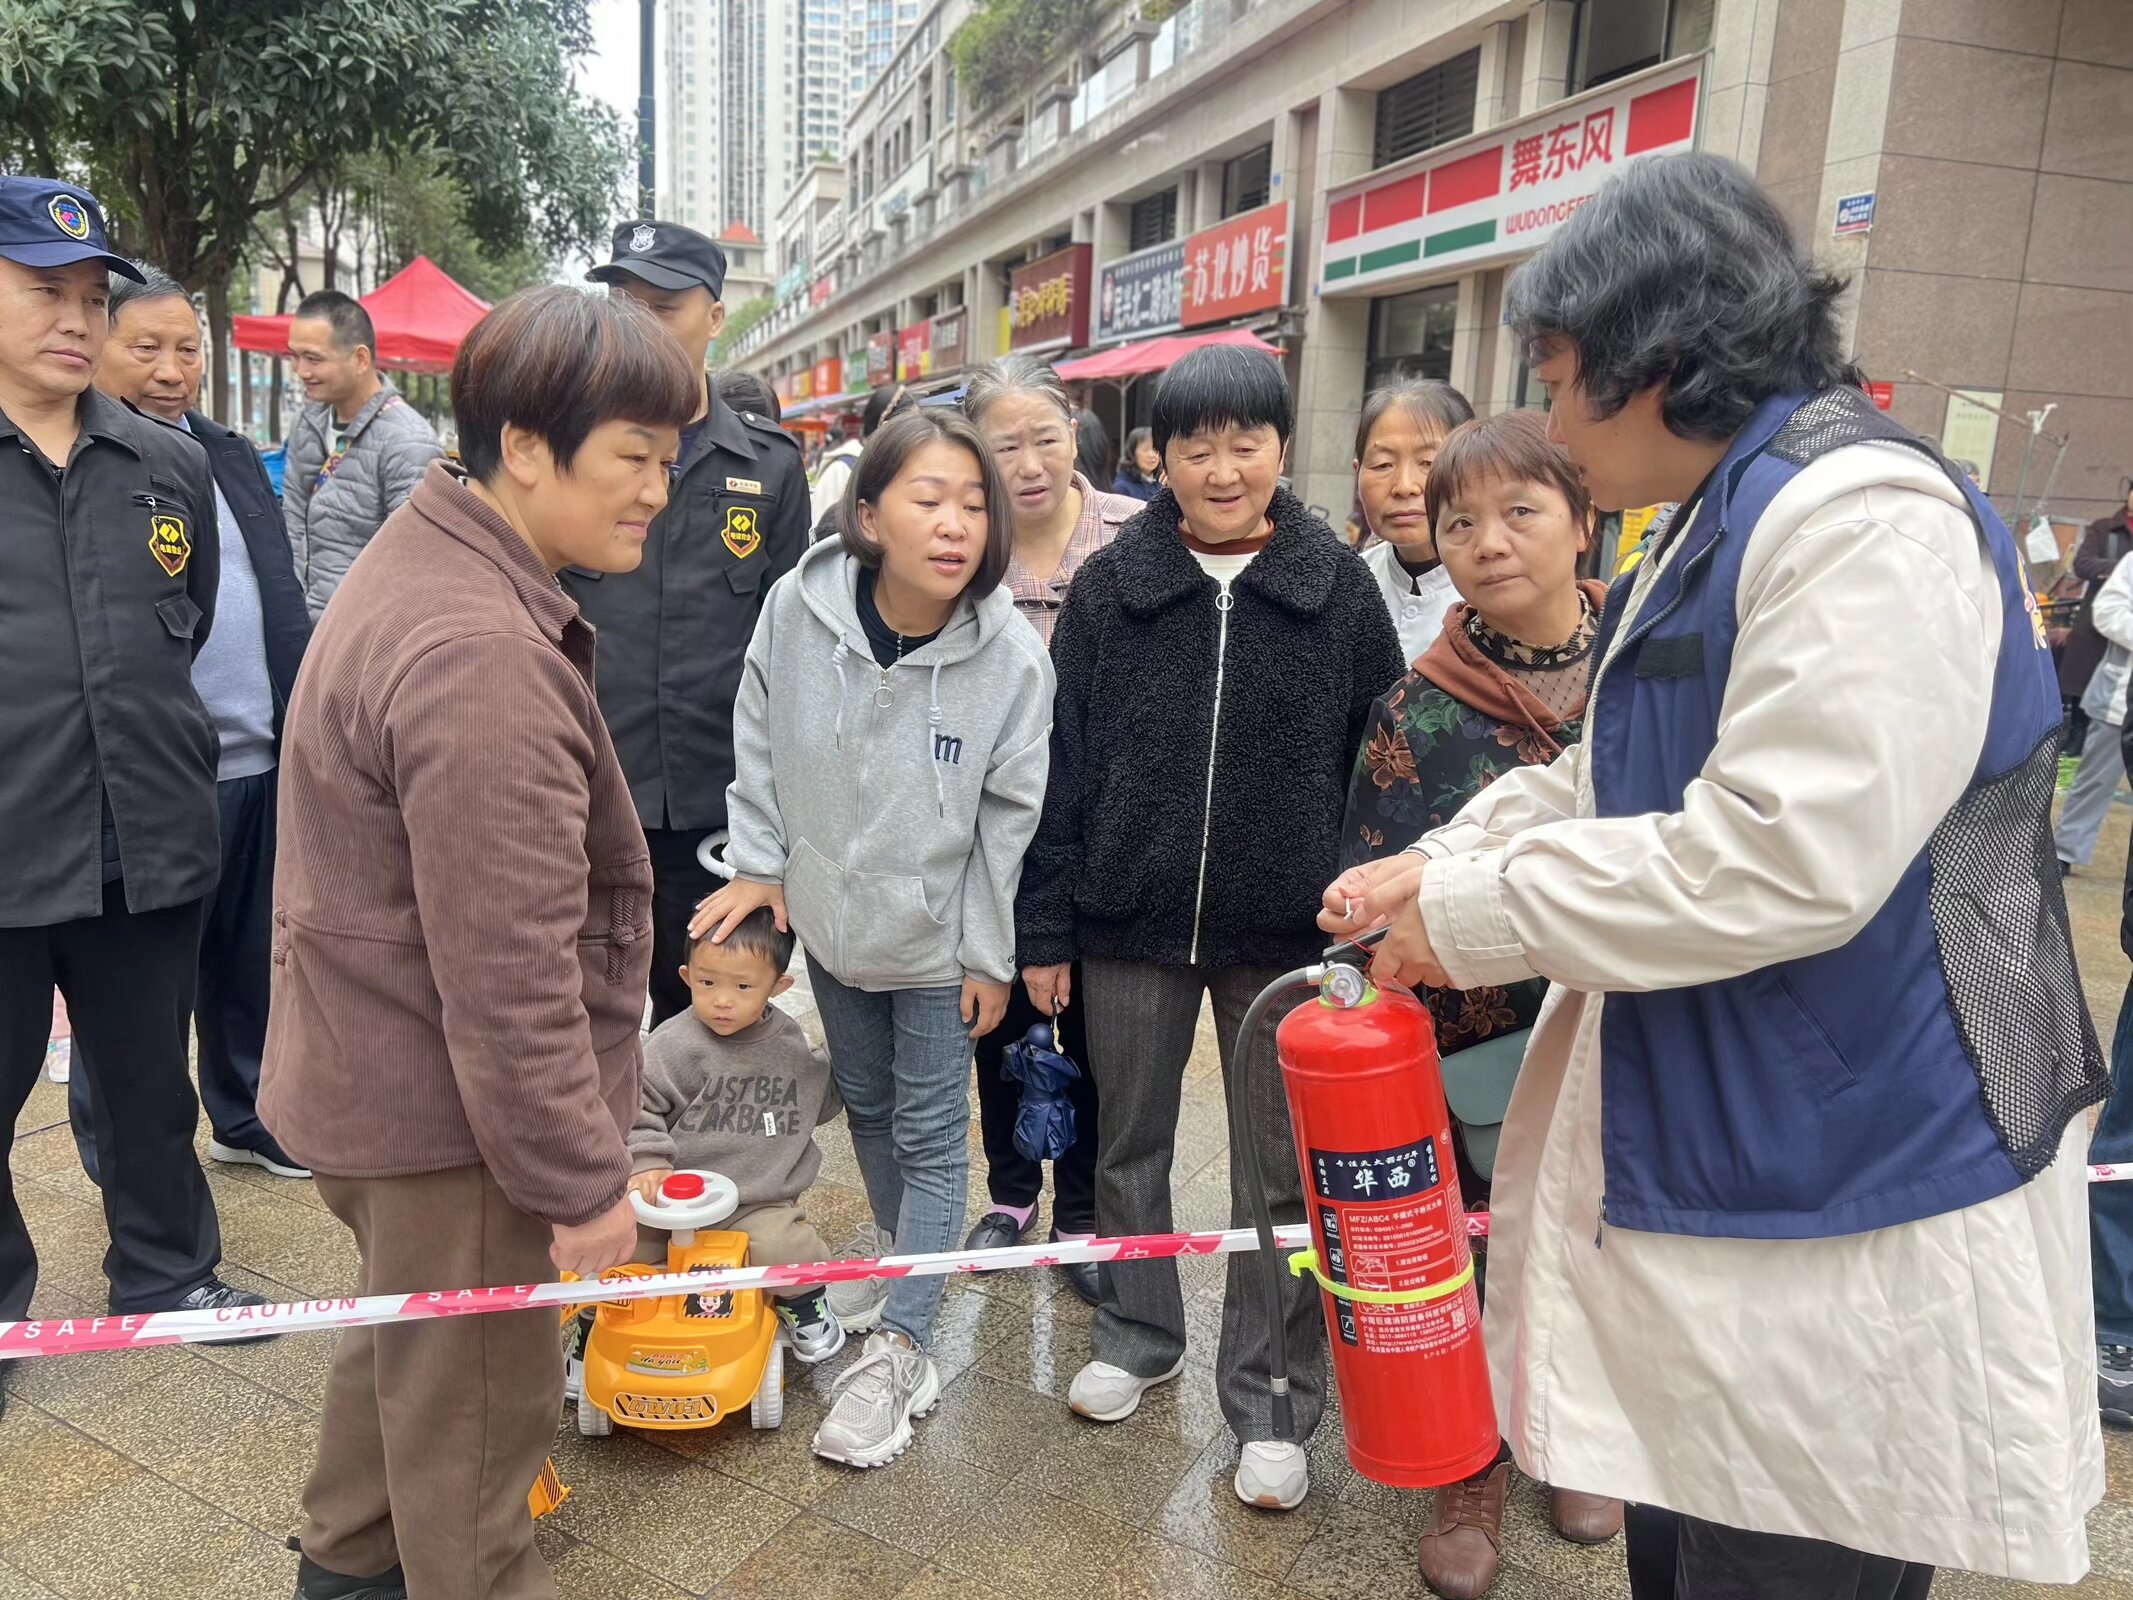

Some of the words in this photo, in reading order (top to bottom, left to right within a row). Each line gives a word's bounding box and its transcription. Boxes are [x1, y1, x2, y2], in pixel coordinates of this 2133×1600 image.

[1509, 106, 1615, 192] 舞东风
[1192, 225, 1273, 306] 苏北炒货
[935, 733, 963, 765] m
[1352, 1165, 1411, 1197] 华西
[23, 1314, 139, 1339] SAFE
[216, 1297, 358, 1322] CAUTION
